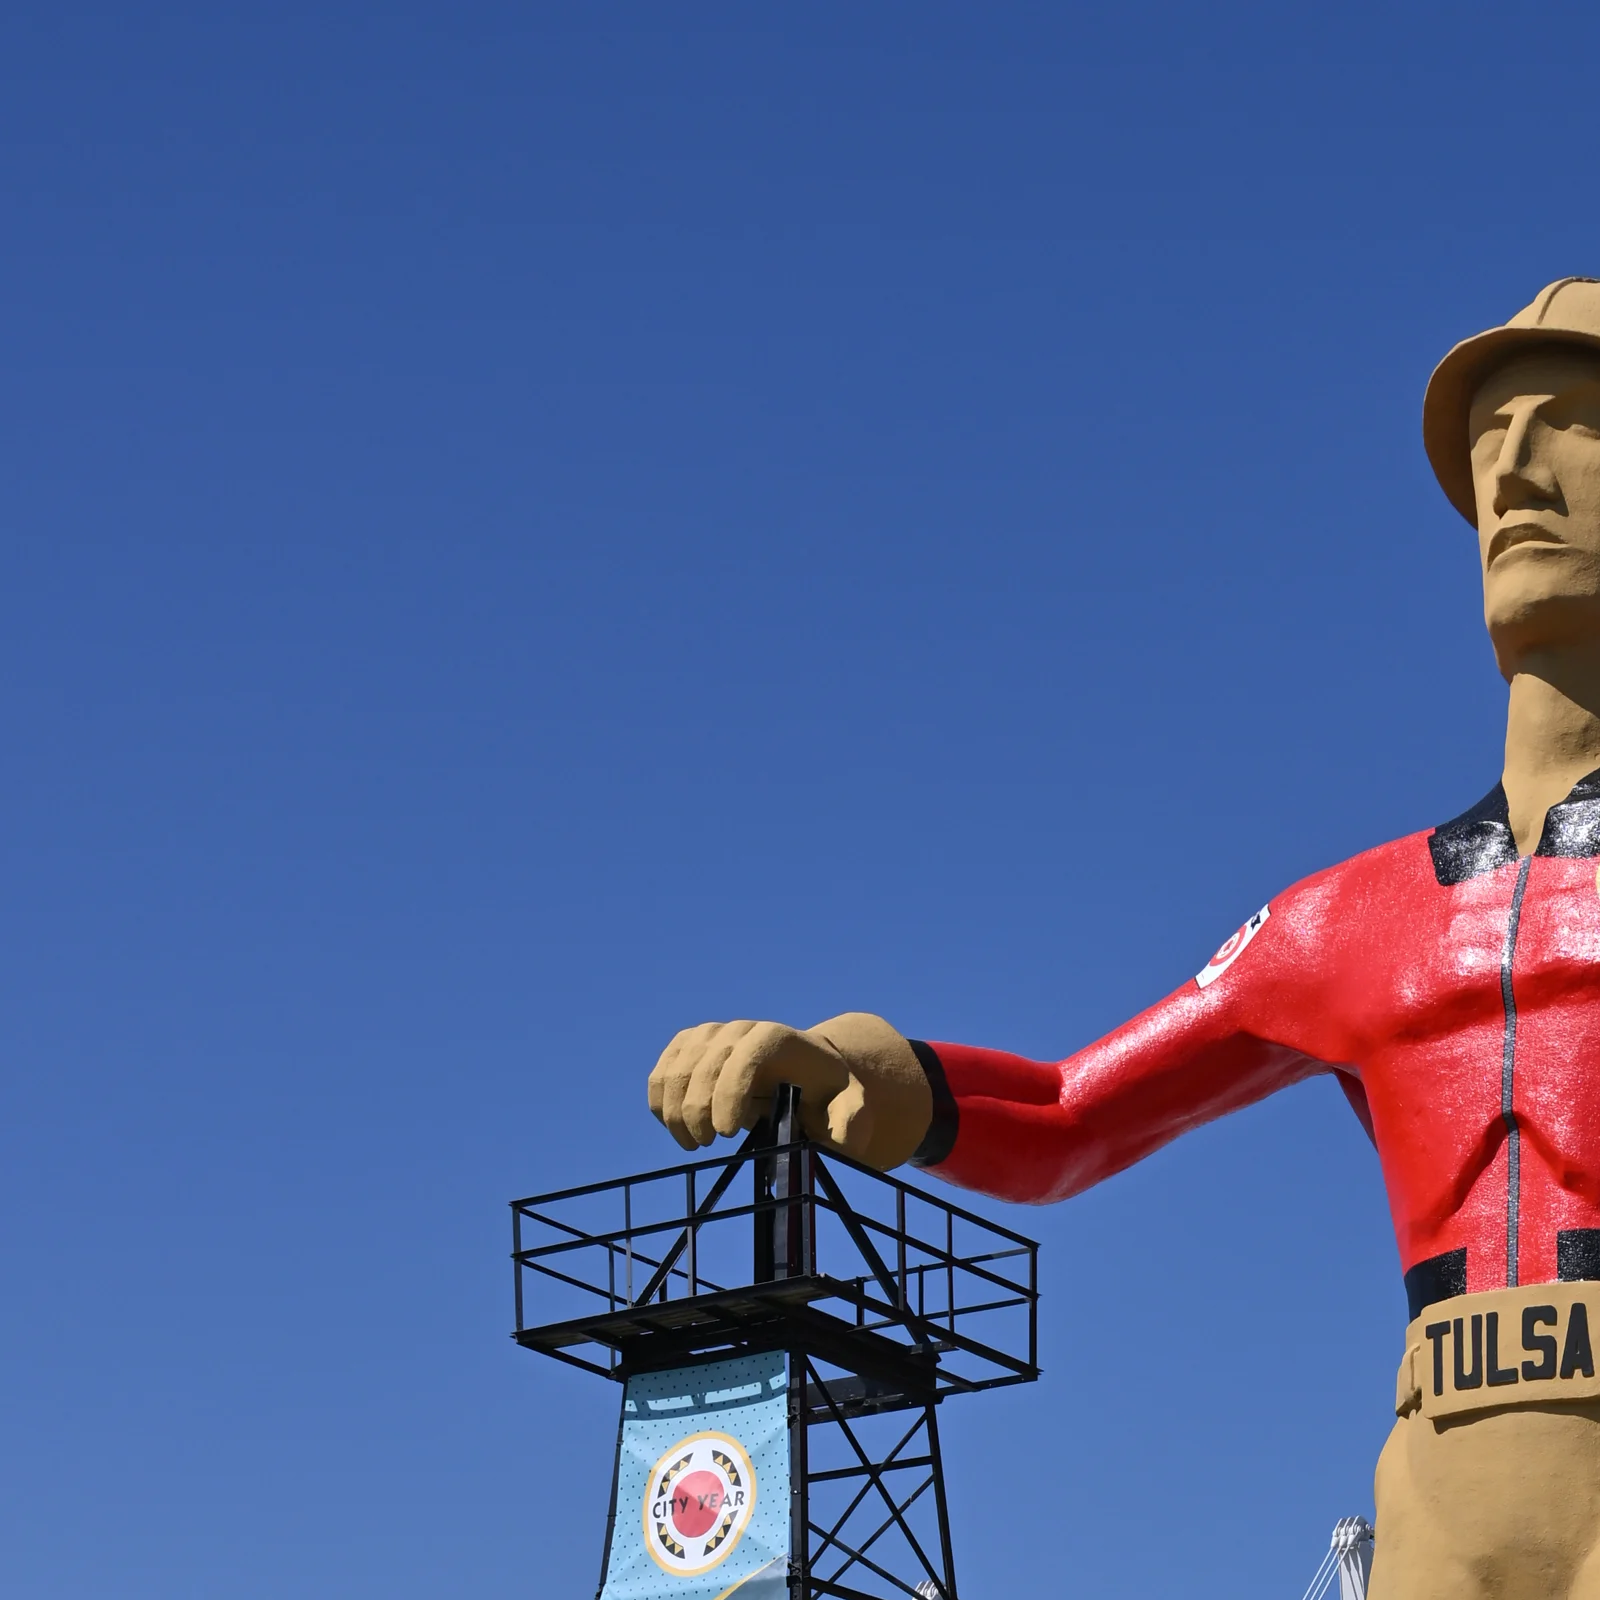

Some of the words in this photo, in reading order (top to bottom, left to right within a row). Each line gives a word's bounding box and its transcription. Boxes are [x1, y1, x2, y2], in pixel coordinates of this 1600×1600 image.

[1425, 1303, 1595, 1396] TULSA
[652, 1496, 688, 1519] CITY
[697, 1490, 745, 1511] YEAR
